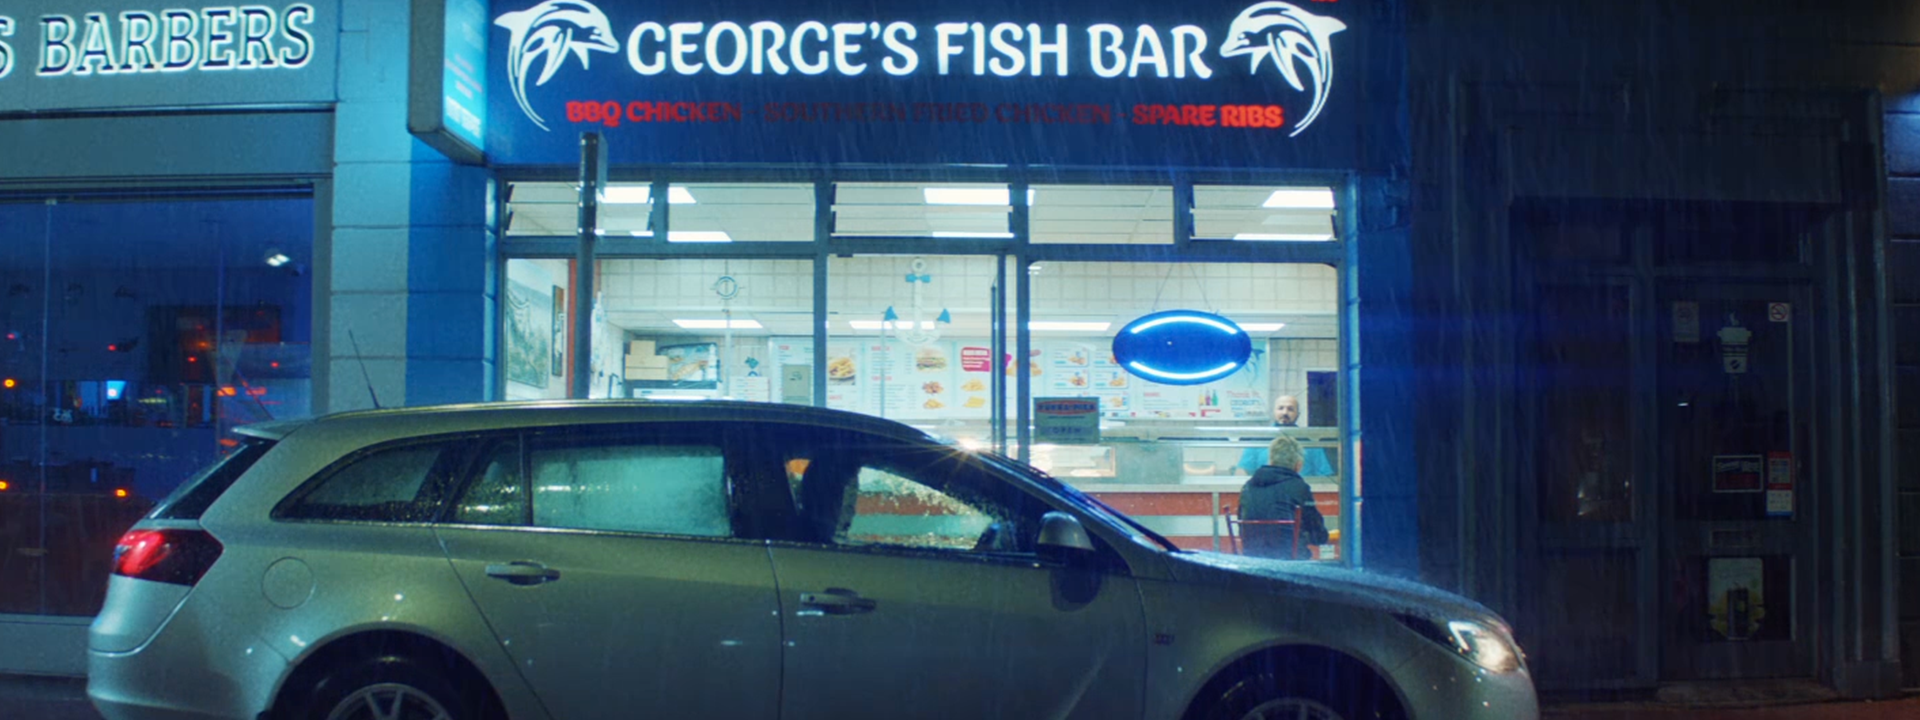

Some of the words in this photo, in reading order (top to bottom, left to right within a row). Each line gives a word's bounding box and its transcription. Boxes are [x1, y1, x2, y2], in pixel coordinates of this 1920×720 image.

[36, 3, 314, 76] BARBERS
[627, 21, 919, 75] GEORGE'S
[934, 22, 1068, 76] FISH
[1087, 23, 1213, 79] BAR
[566, 101, 622, 127] BBQ
[625, 101, 742, 122] CHICKEN
[763, 101, 906, 123] SOUTHERN
[913, 102, 988, 124] FRIED
[994, 102, 1111, 124] CHICKEN
[1132, 104, 1216, 126] SPARE
[1220, 104, 1284, 128] RIBS
